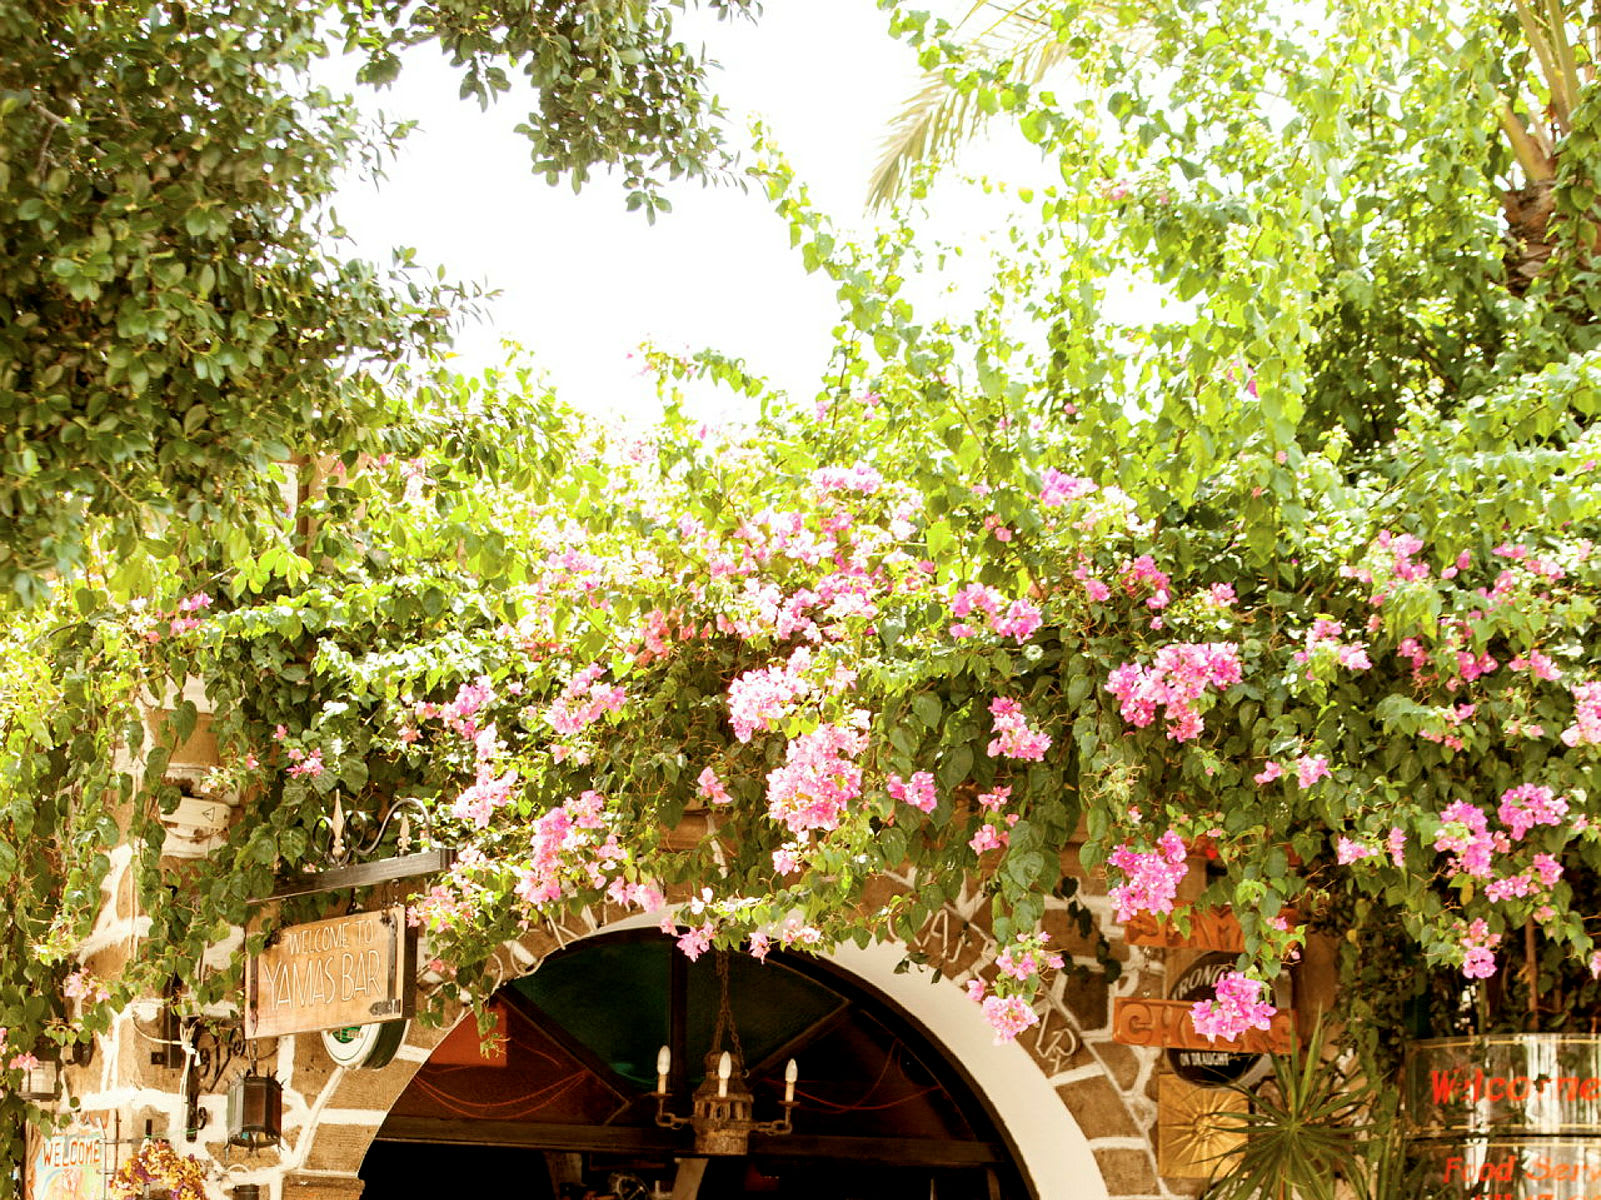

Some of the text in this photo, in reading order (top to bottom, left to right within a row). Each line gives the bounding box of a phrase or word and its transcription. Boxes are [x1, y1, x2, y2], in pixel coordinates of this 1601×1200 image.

[288, 919, 375, 955] WELCOME TO
[263, 949, 382, 1011] YAMAS BAR
[43, 1139, 100, 1167] WELCOME
[1443, 1155, 1517, 1183] Food
